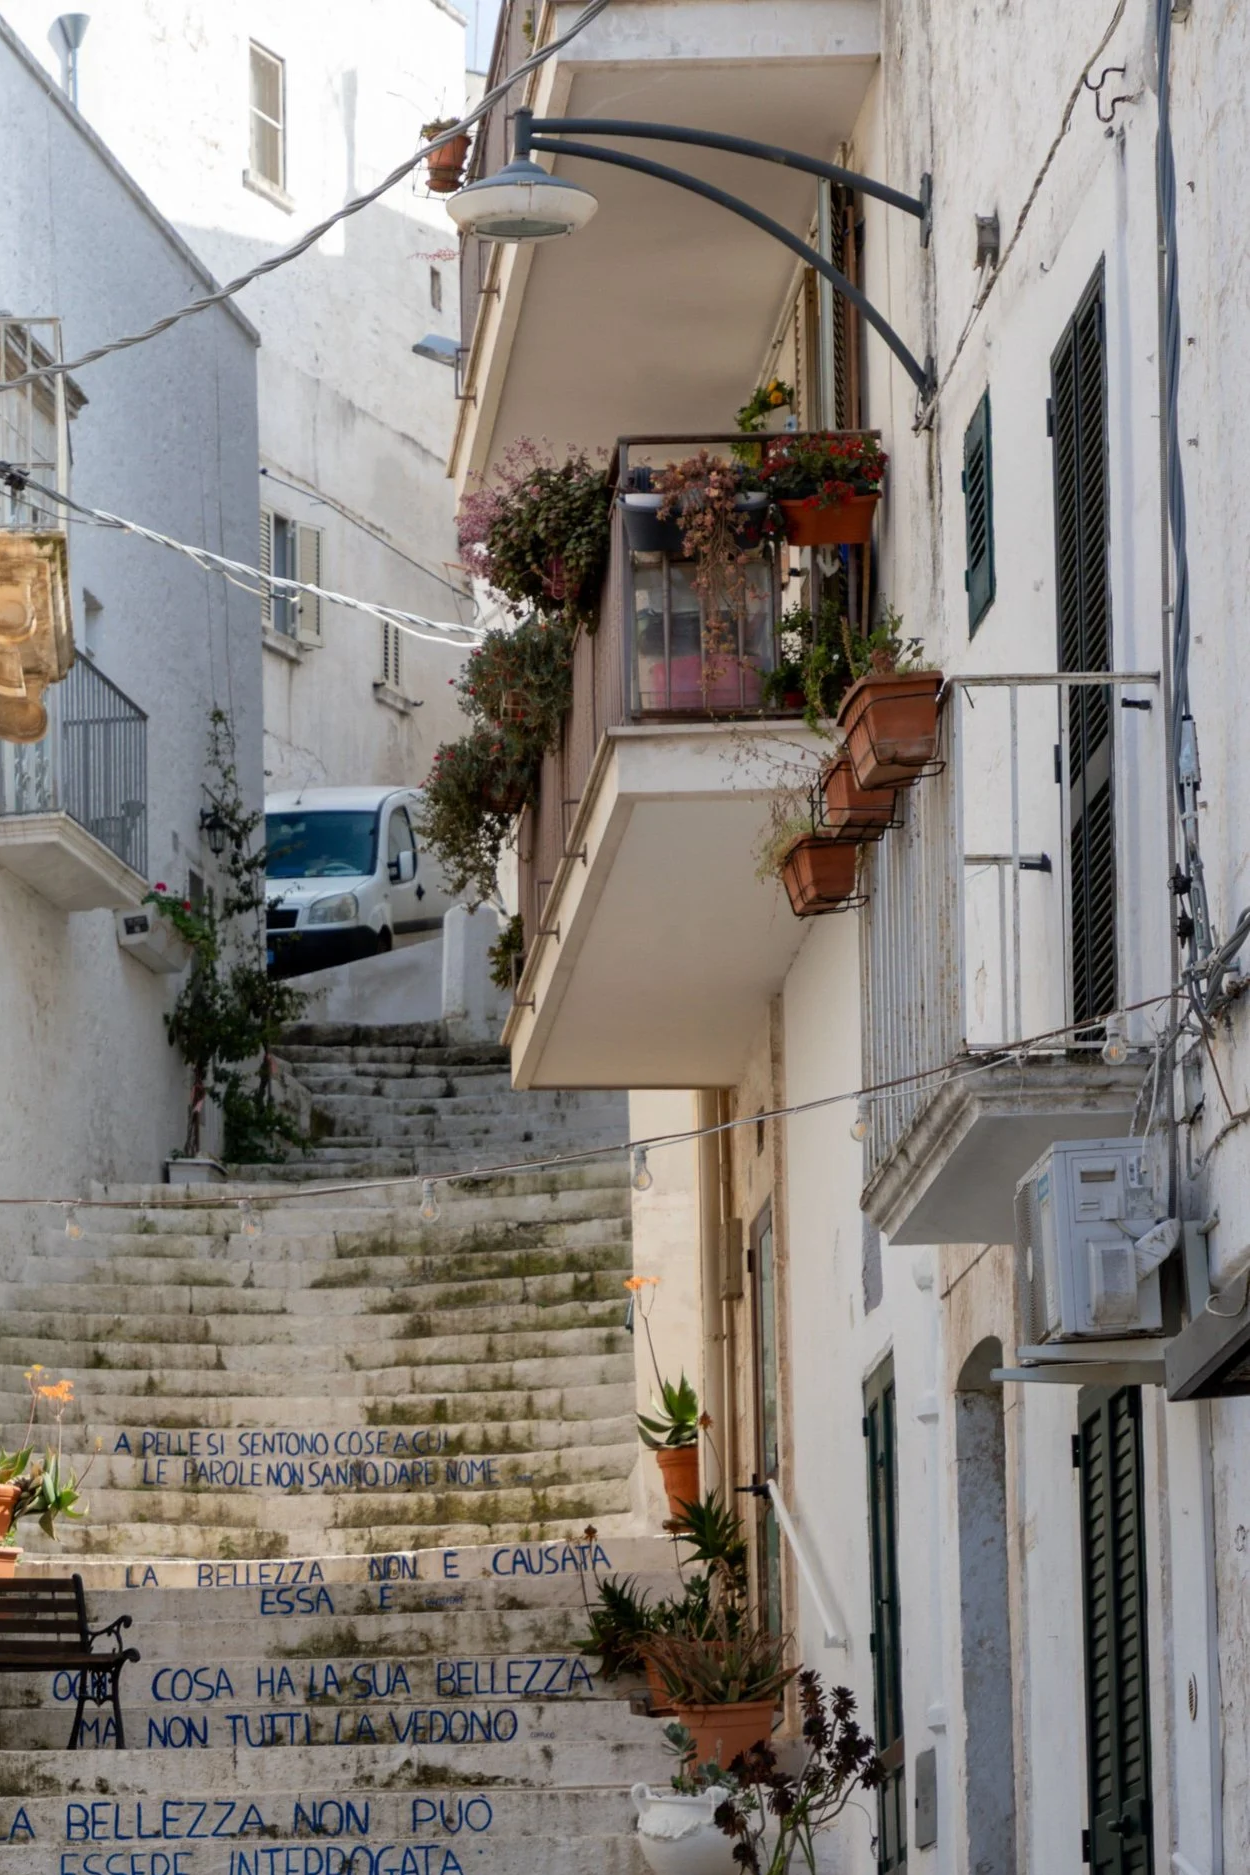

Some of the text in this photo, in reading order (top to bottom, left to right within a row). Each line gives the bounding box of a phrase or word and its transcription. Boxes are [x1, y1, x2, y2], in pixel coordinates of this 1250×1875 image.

[114, 1430, 448, 1457] A PELLE SI SENTONO COSE A CUI
[143, 1458, 168, 1485] LE
[183, 1459, 263, 1487] PAROLE
[266, 1461, 304, 1488] NON
[308, 1460, 379, 1487] SANNO
[384, 1460, 436, 1486] DARE
[446, 1458, 500, 1485] NOME
[125, 1564, 159, 1588] LA
[197, 1561, 325, 1587] BELLEZZA
[369, 1554, 417, 1581] NON
[492, 1544, 612, 1576] CAUSATA
[260, 1586, 334, 1616] ESSA
[151, 1667, 234, 1701] COSA
[257, 1666, 296, 1698] HA
[310, 1663, 342, 1697] LA
[353, 1663, 412, 1699] SUA
[436, 1658, 594, 1697] BELLEZZA
[79, 1709, 519, 1748] MA NON TUTTI LA VEDONO
[66, 1801, 265, 1841] BELLEZZA
[293, 1800, 370, 1837] NON
[412, 1794, 493, 1833] PUÒ
